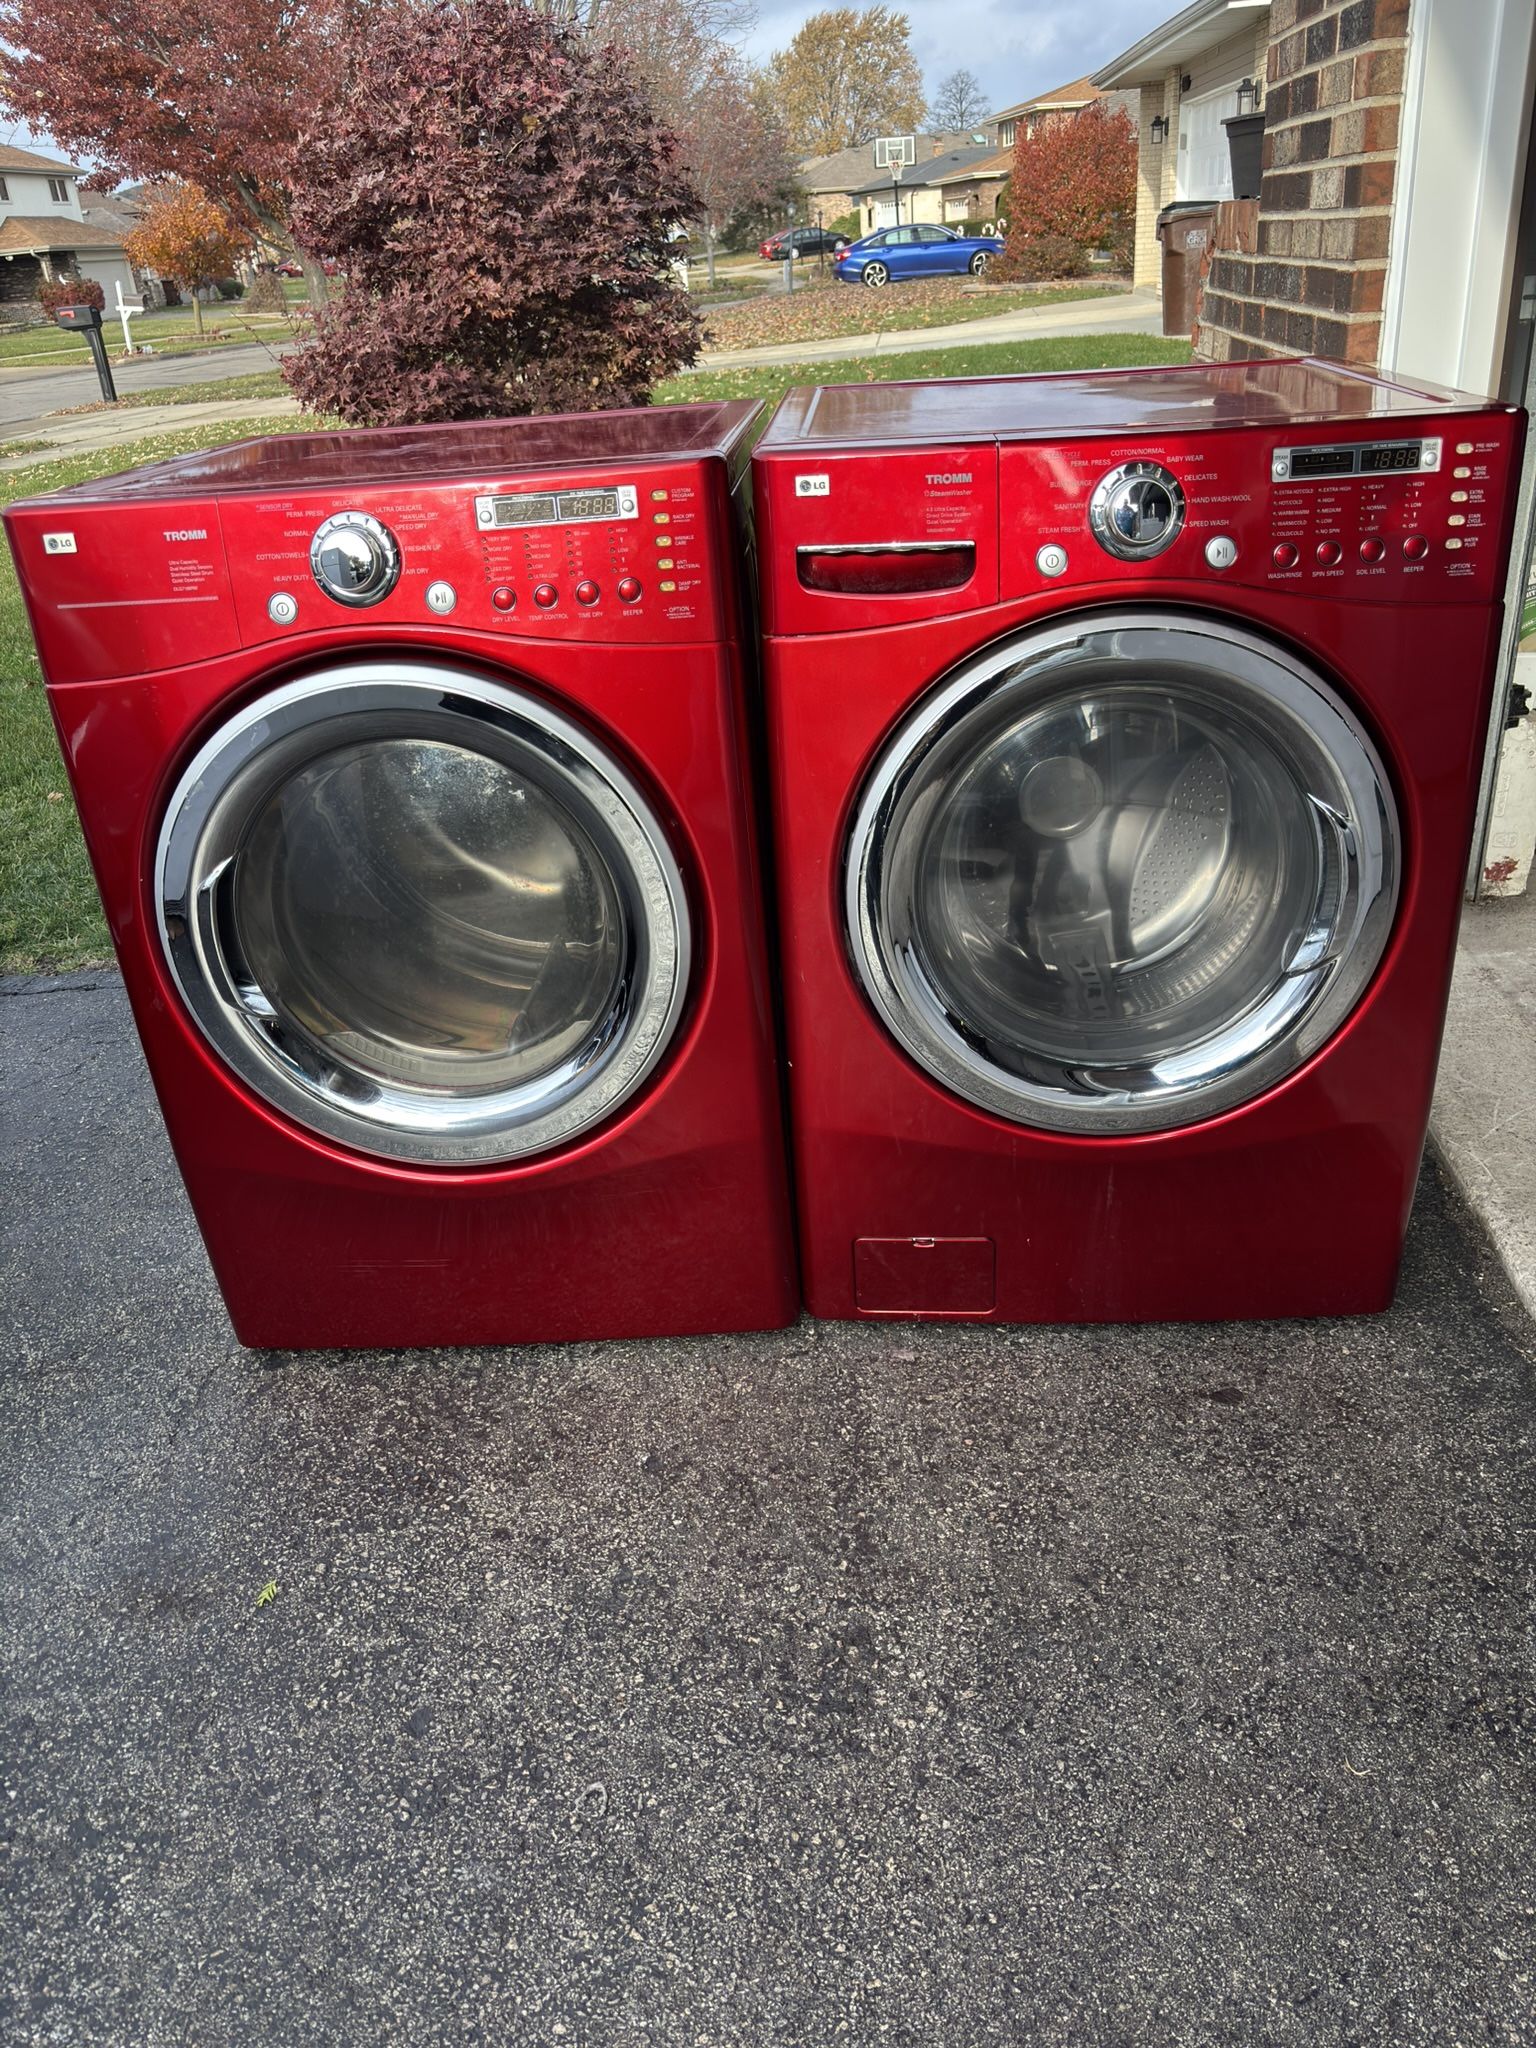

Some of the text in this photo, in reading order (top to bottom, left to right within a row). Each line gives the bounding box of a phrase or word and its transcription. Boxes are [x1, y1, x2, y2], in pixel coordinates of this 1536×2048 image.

[1111, 448, 1166, 456] COTTON/NORMAL
[925, 473, 973, 484] TROMM
[163, 529, 207, 541] TROMM
[60, 539, 71, 547] LG
[256, 552, 305, 560] COTTON/TOWELS
